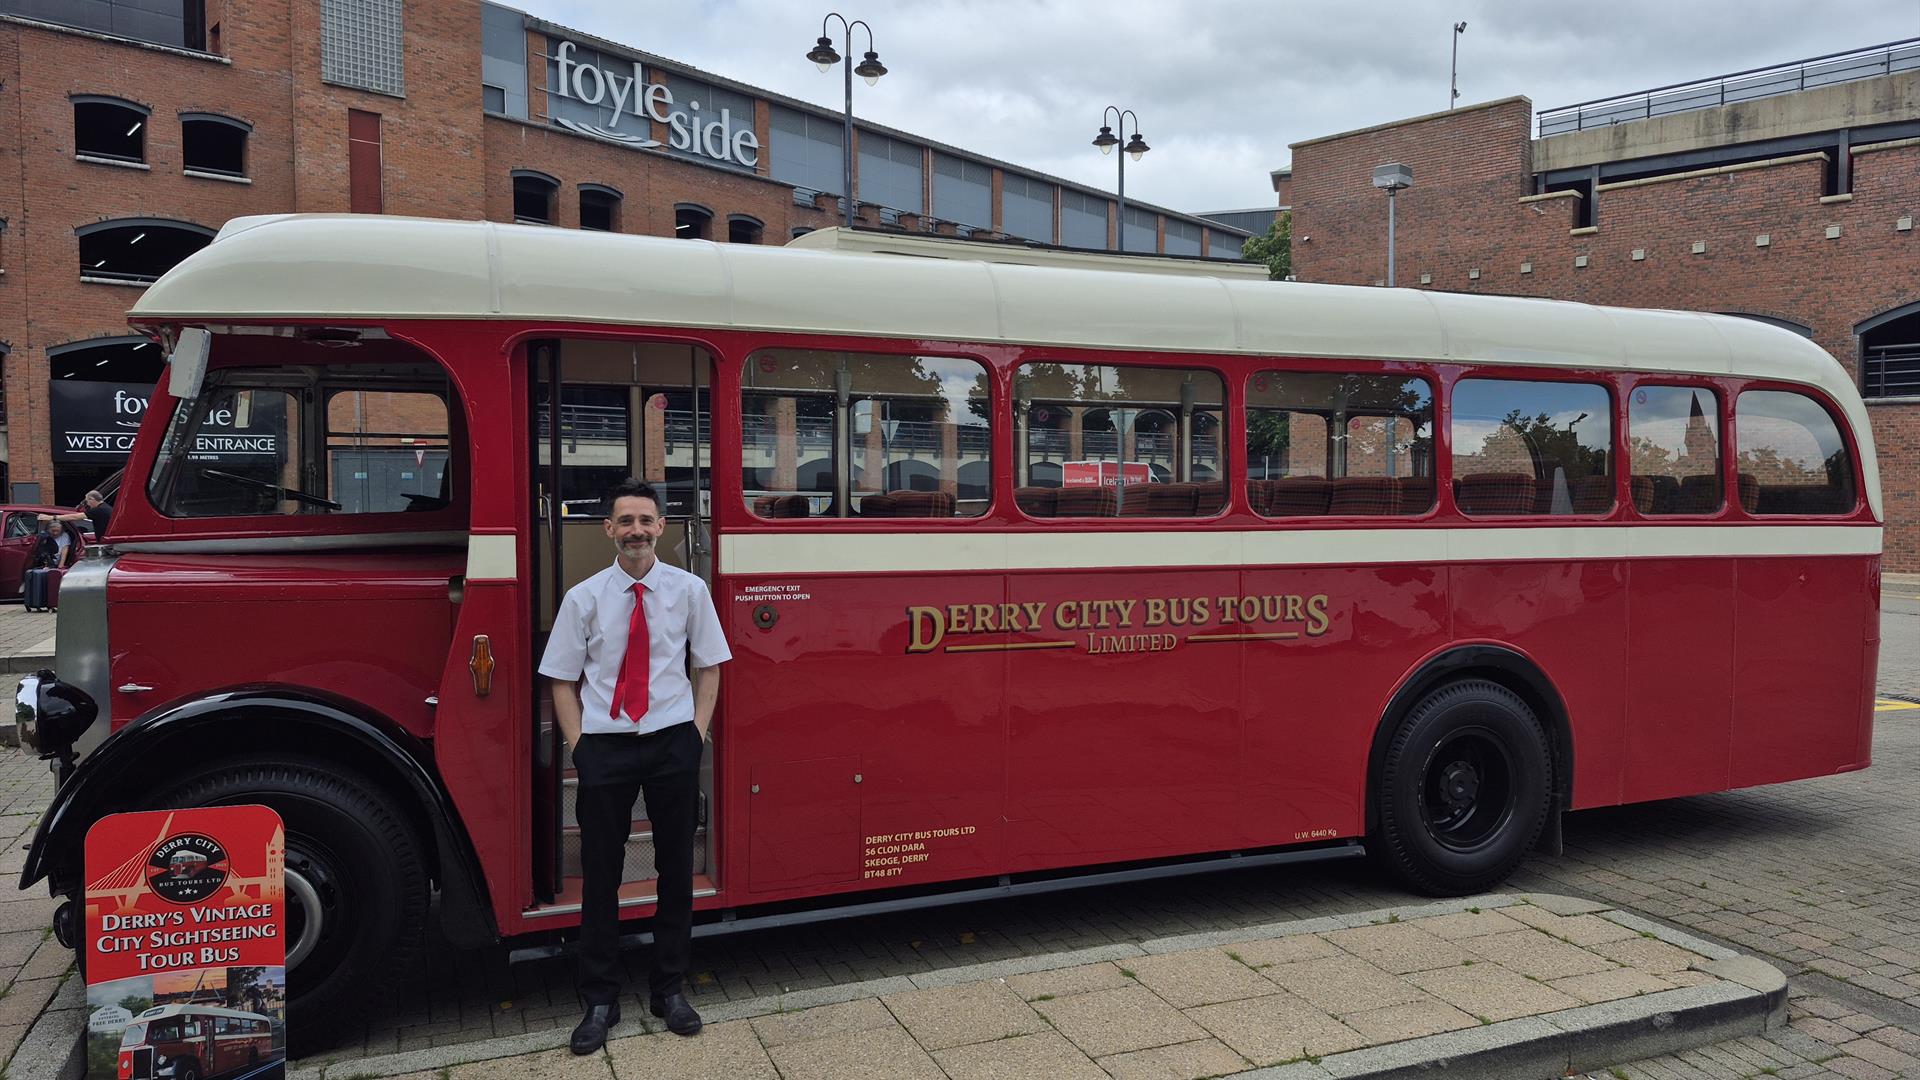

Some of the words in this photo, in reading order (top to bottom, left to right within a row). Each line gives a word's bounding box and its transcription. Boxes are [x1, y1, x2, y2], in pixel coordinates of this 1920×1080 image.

[65, 436, 111, 449] WEST
[196, 437, 276, 451] ENTRANCE
[906, 603, 1047, 654] DERRY
[1054, 599, 1137, 630] CITY
[1144, 596, 1210, 628] BUS
[1217, 594, 1329, 637] TOURS
[1086, 632, 1177, 654] LIMITED
[865, 834, 893, 844] DERRY
[894, 832, 913, 841] CITY
[914, 831, 931, 840] BUS
[932, 828, 960, 838] TOURS
[960, 826, 976, 835] LTD
[1311, 830, 1327, 838] 6440
[1328, 829, 1337, 837] Kg
[156, 837, 191, 858] DERRY
[195, 838, 220, 854] CITY
[877, 845, 900, 855] CLON
[901, 843, 925, 852] DARA
[902, 853, 929, 863] DERRY
[864, 869, 885, 879] BT48
[886, 867, 902, 876] 8TY
[102, 911, 183, 932] DERRY'S
[190, 903, 272, 924] VINTAGE
[96, 935, 145, 953] CITY
[150, 923, 277, 949] SIGHTSEEING
[136, 951, 195, 970] TOUR
[200, 947, 240, 964] BUS
